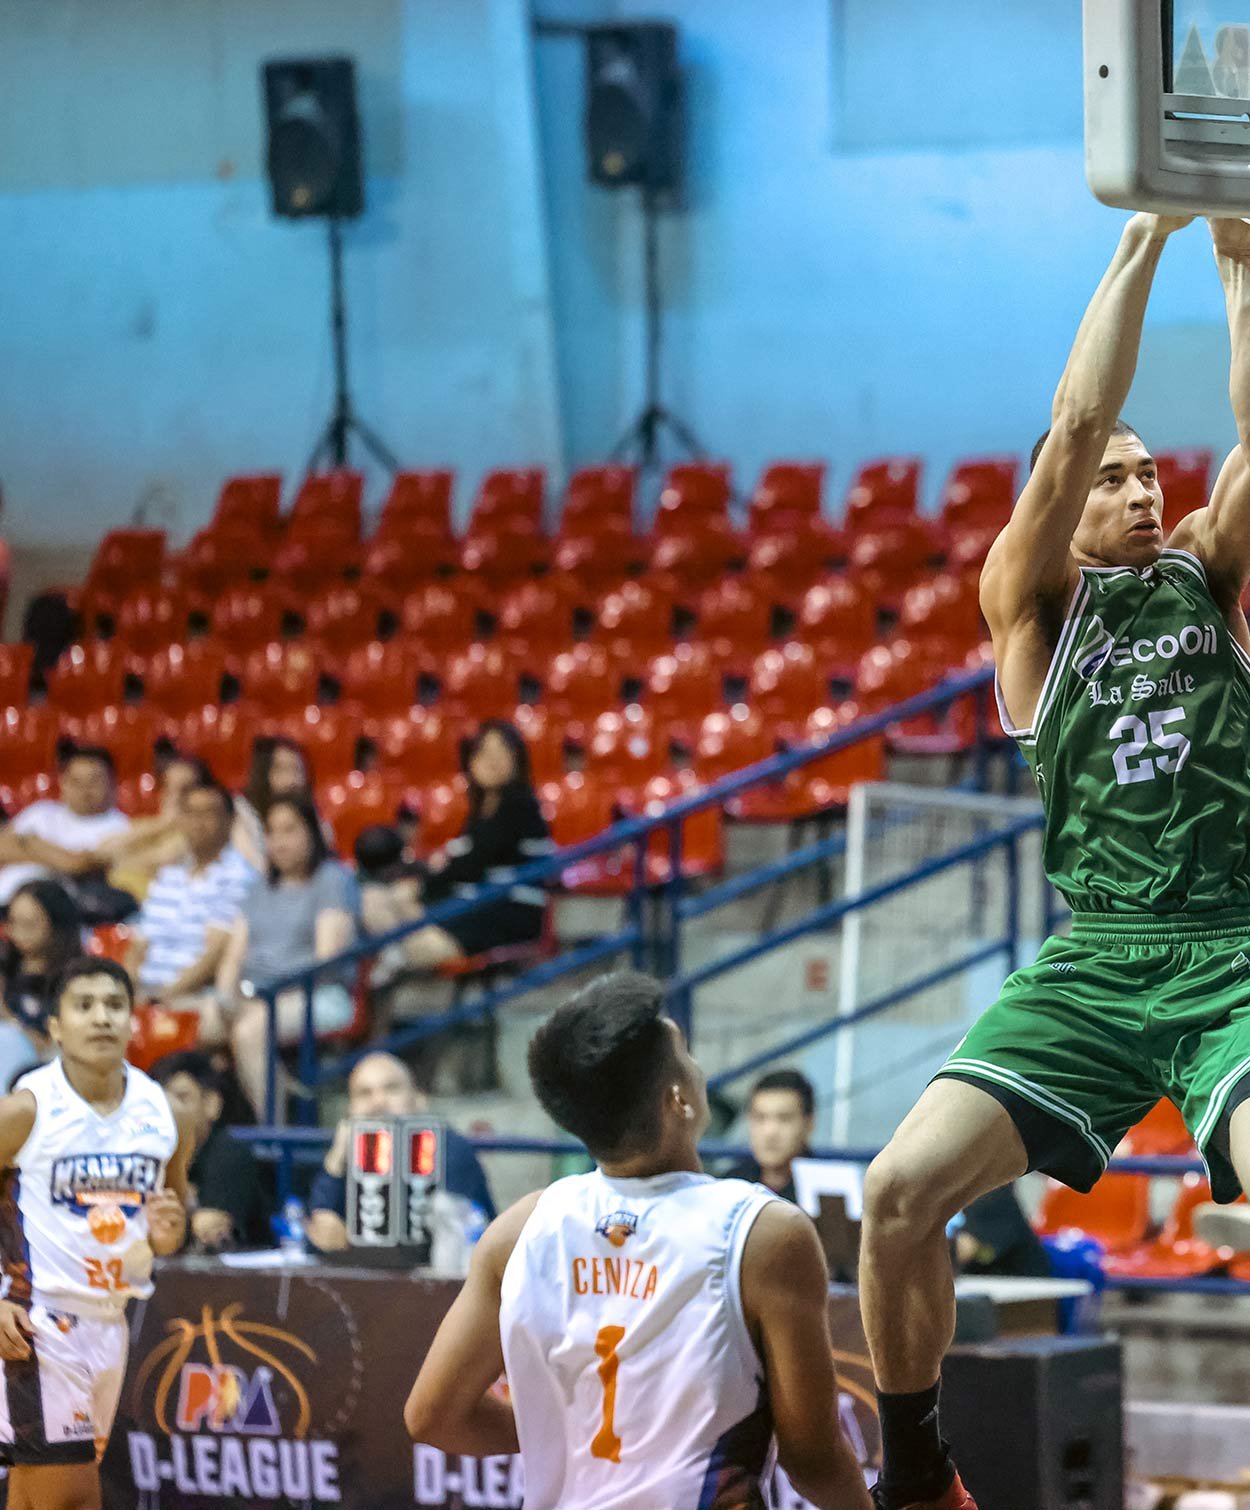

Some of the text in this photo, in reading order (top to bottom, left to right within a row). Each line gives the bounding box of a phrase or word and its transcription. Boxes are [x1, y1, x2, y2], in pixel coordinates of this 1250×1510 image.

[1110, 625, 1217, 667] EcoOil
[1088, 669, 1195, 708] La Salle
[1109, 706, 1190, 785] 25
[572, 1257, 657, 1300] CENIZA
[590, 1325, 626, 1464] 1
[128, 1431, 342, 1502] D-LEAGUE
